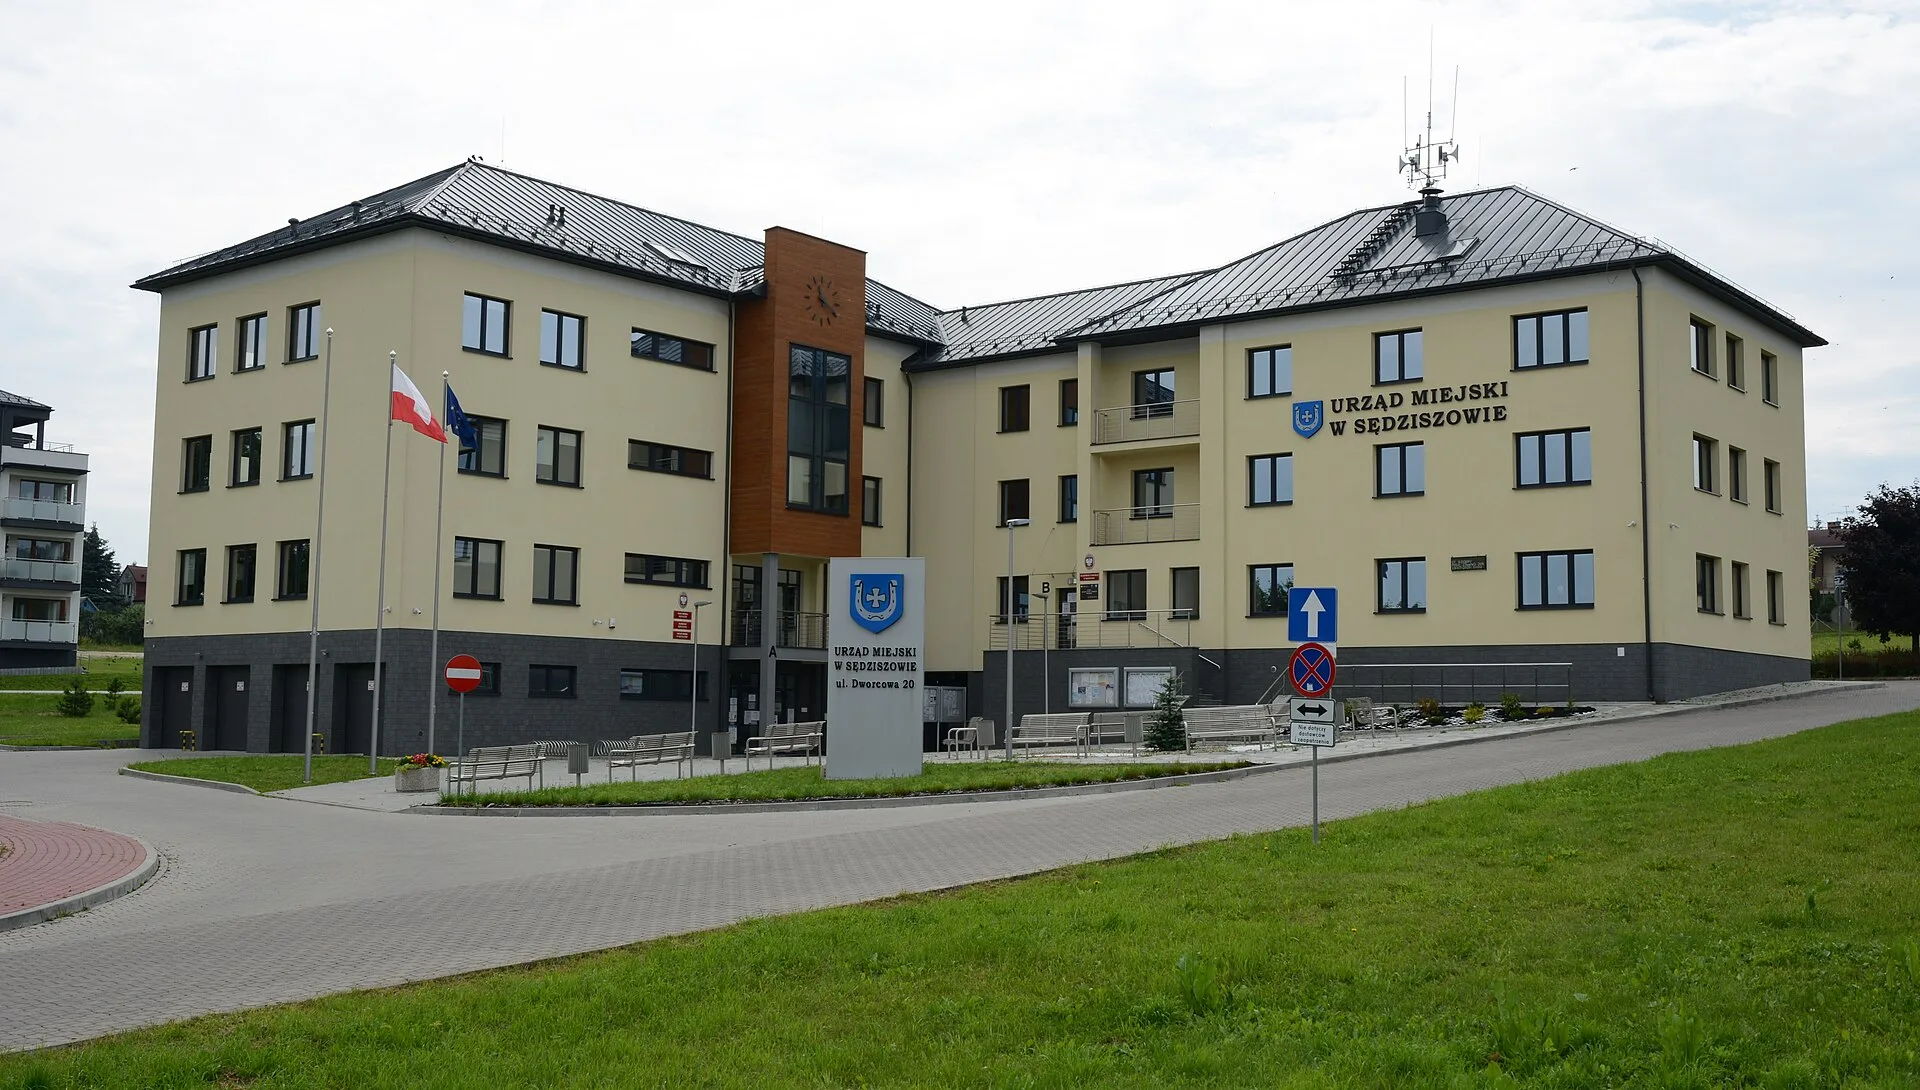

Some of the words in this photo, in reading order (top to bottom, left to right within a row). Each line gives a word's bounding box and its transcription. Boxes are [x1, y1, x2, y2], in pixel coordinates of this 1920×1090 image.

[1330, 391, 1404, 414] URZĄD
[1411, 381, 1509, 406] MIEJSKI
[1329, 421, 1347, 436] W
[1354, 405, 1508, 436] SĘDZISZOWIE
[1042, 582, 1050, 593] B
[768, 646, 777, 658] A
[834, 646, 869, 658] URZĄD
[872, 647, 917, 657] MIEJSKI
[834, 661, 843, 671] W
[845, 661, 917, 673] SĘDZISZOWIE
[835, 678, 848, 688] ul.
[851, 679, 900, 689] Dworcowa
[902, 679, 915, 689] 20
